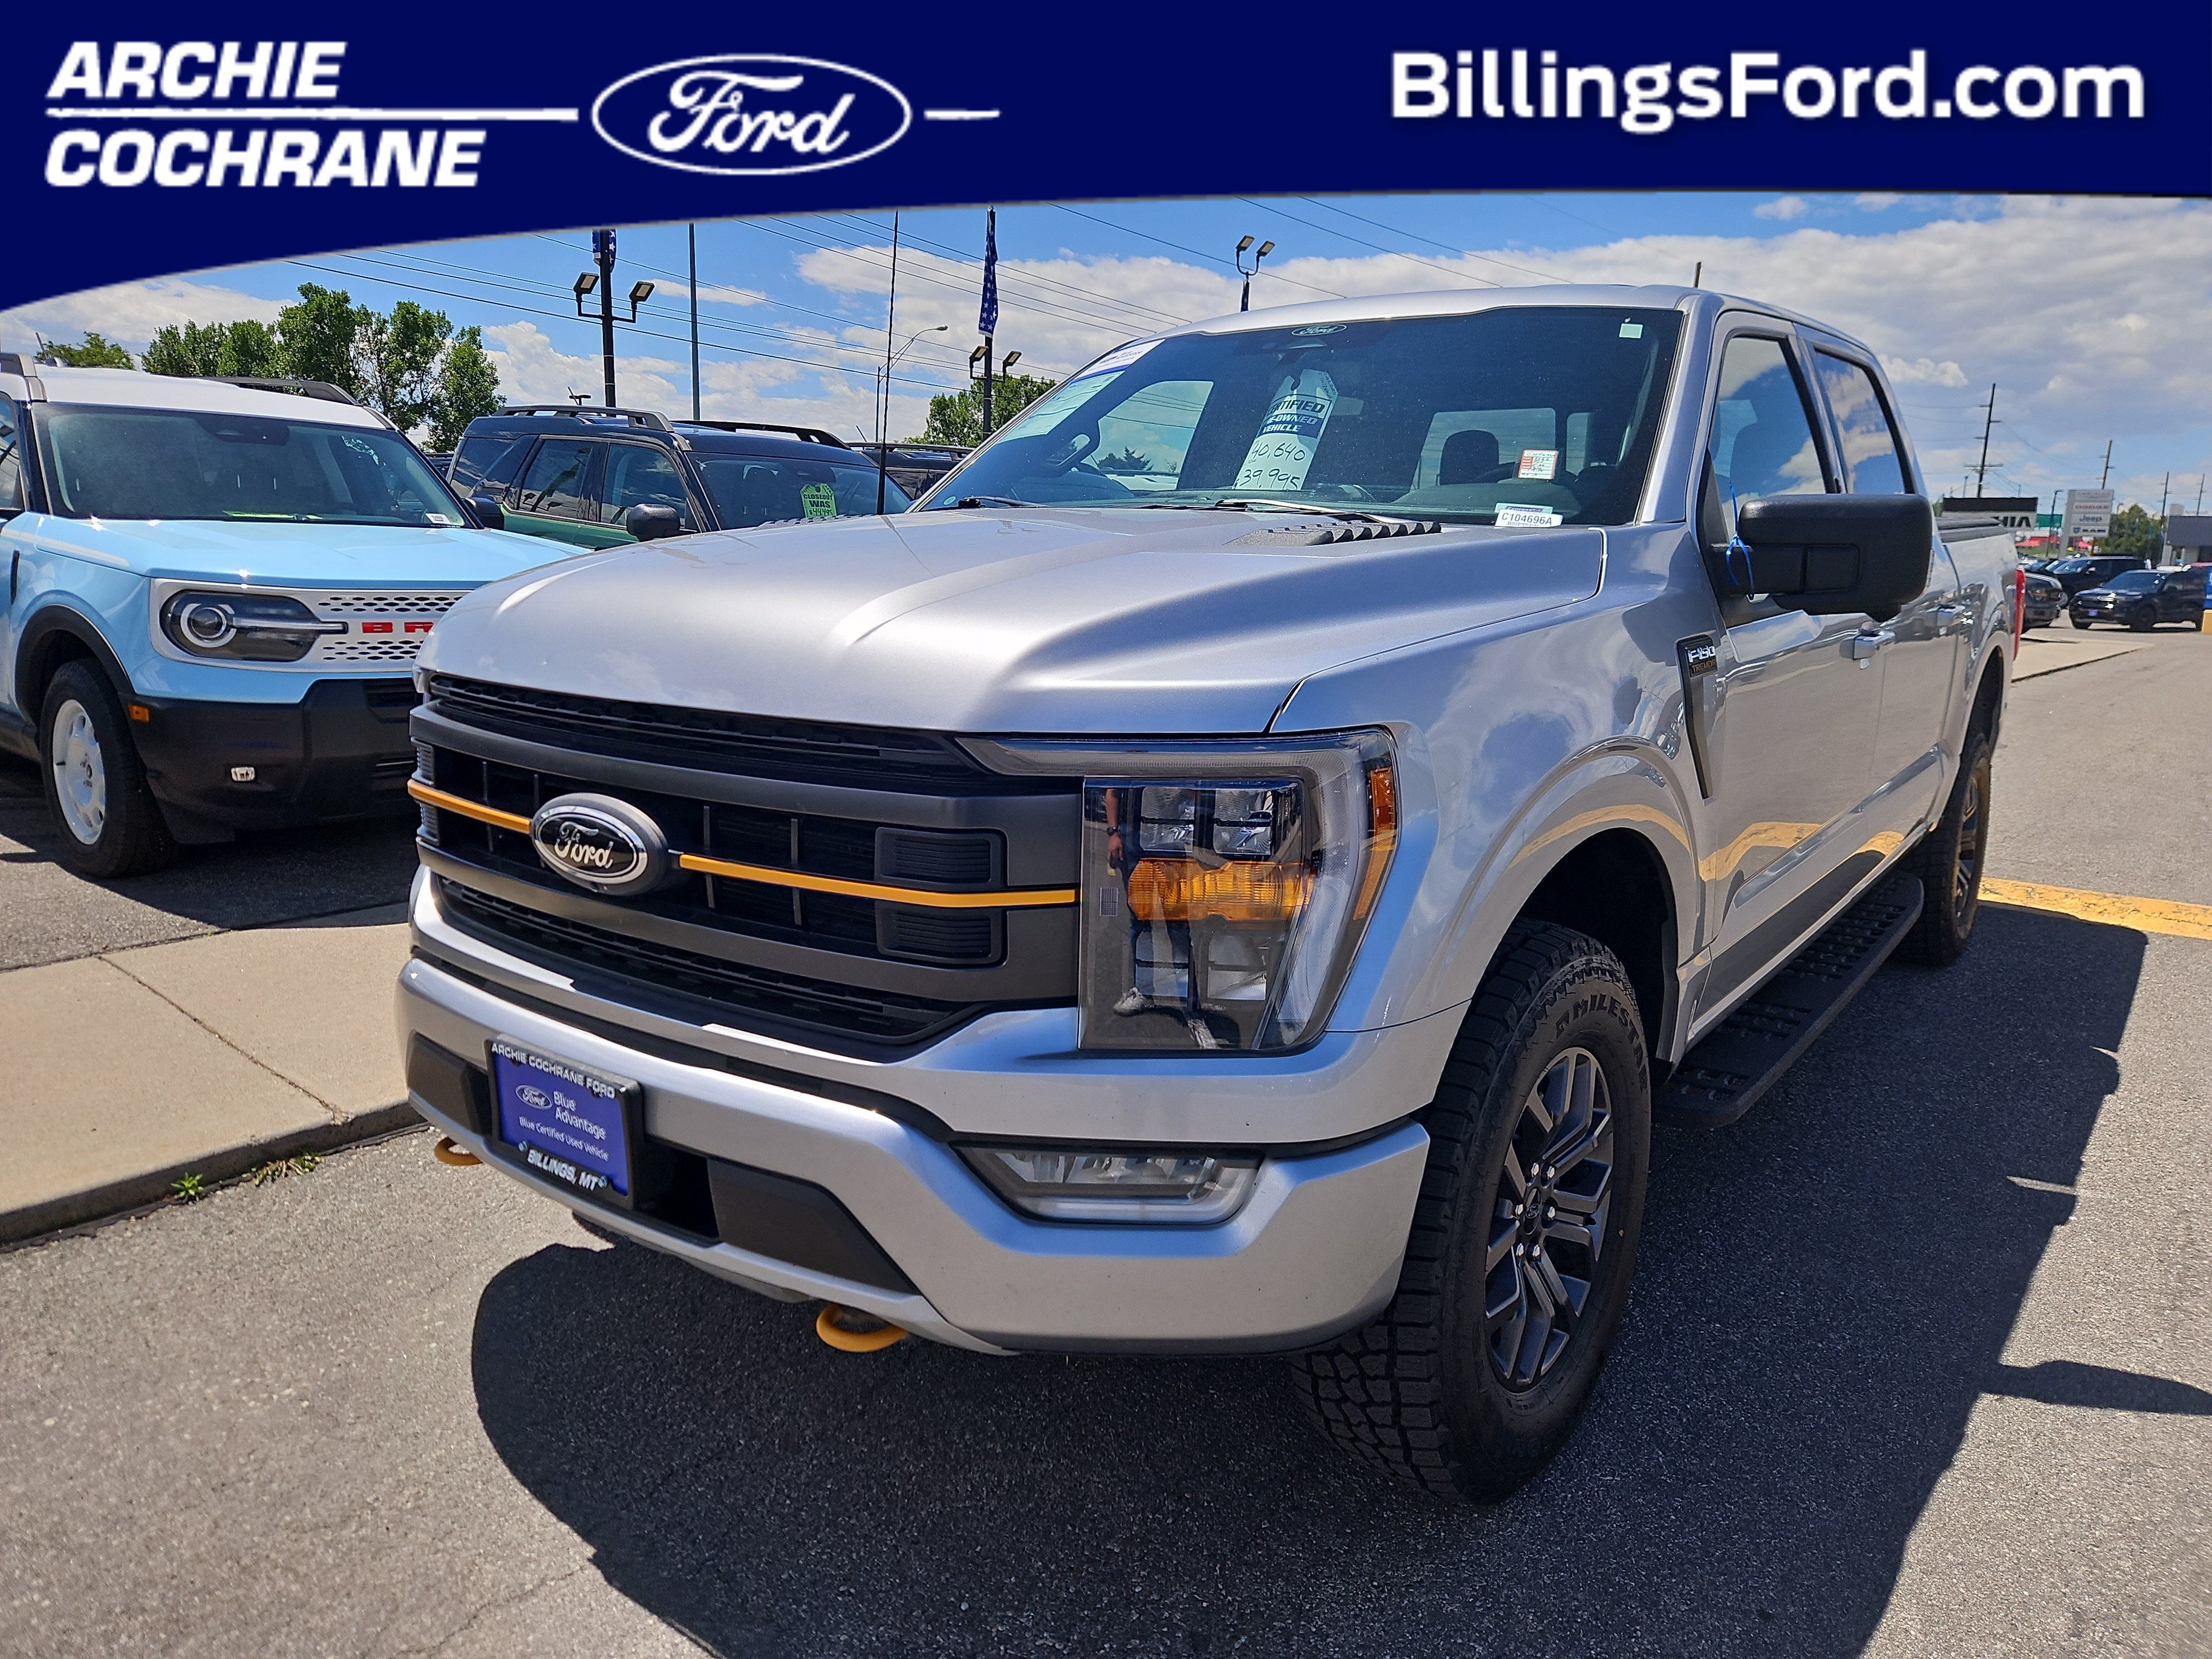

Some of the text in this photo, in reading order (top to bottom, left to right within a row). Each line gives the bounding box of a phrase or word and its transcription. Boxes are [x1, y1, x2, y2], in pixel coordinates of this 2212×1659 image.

[1299, 325, 1339, 335] Ford
[1268, 400, 1326, 414] ERTIFIED
[1251, 441, 1306, 461] 40,640
[1501, 512, 1552, 525] C104696A
[554, 821, 614, 869] Ford
[491, 1042, 615, 1099] ARCHIE COCHRANE FORD
[553, 1090, 576, 1111] Blue
[555, 1107, 606, 1140] Advantage
[519, 1116, 609, 1162] Blue Certified Used Vehicle
[527, 1149, 600, 1191] BILLINGS, MT
